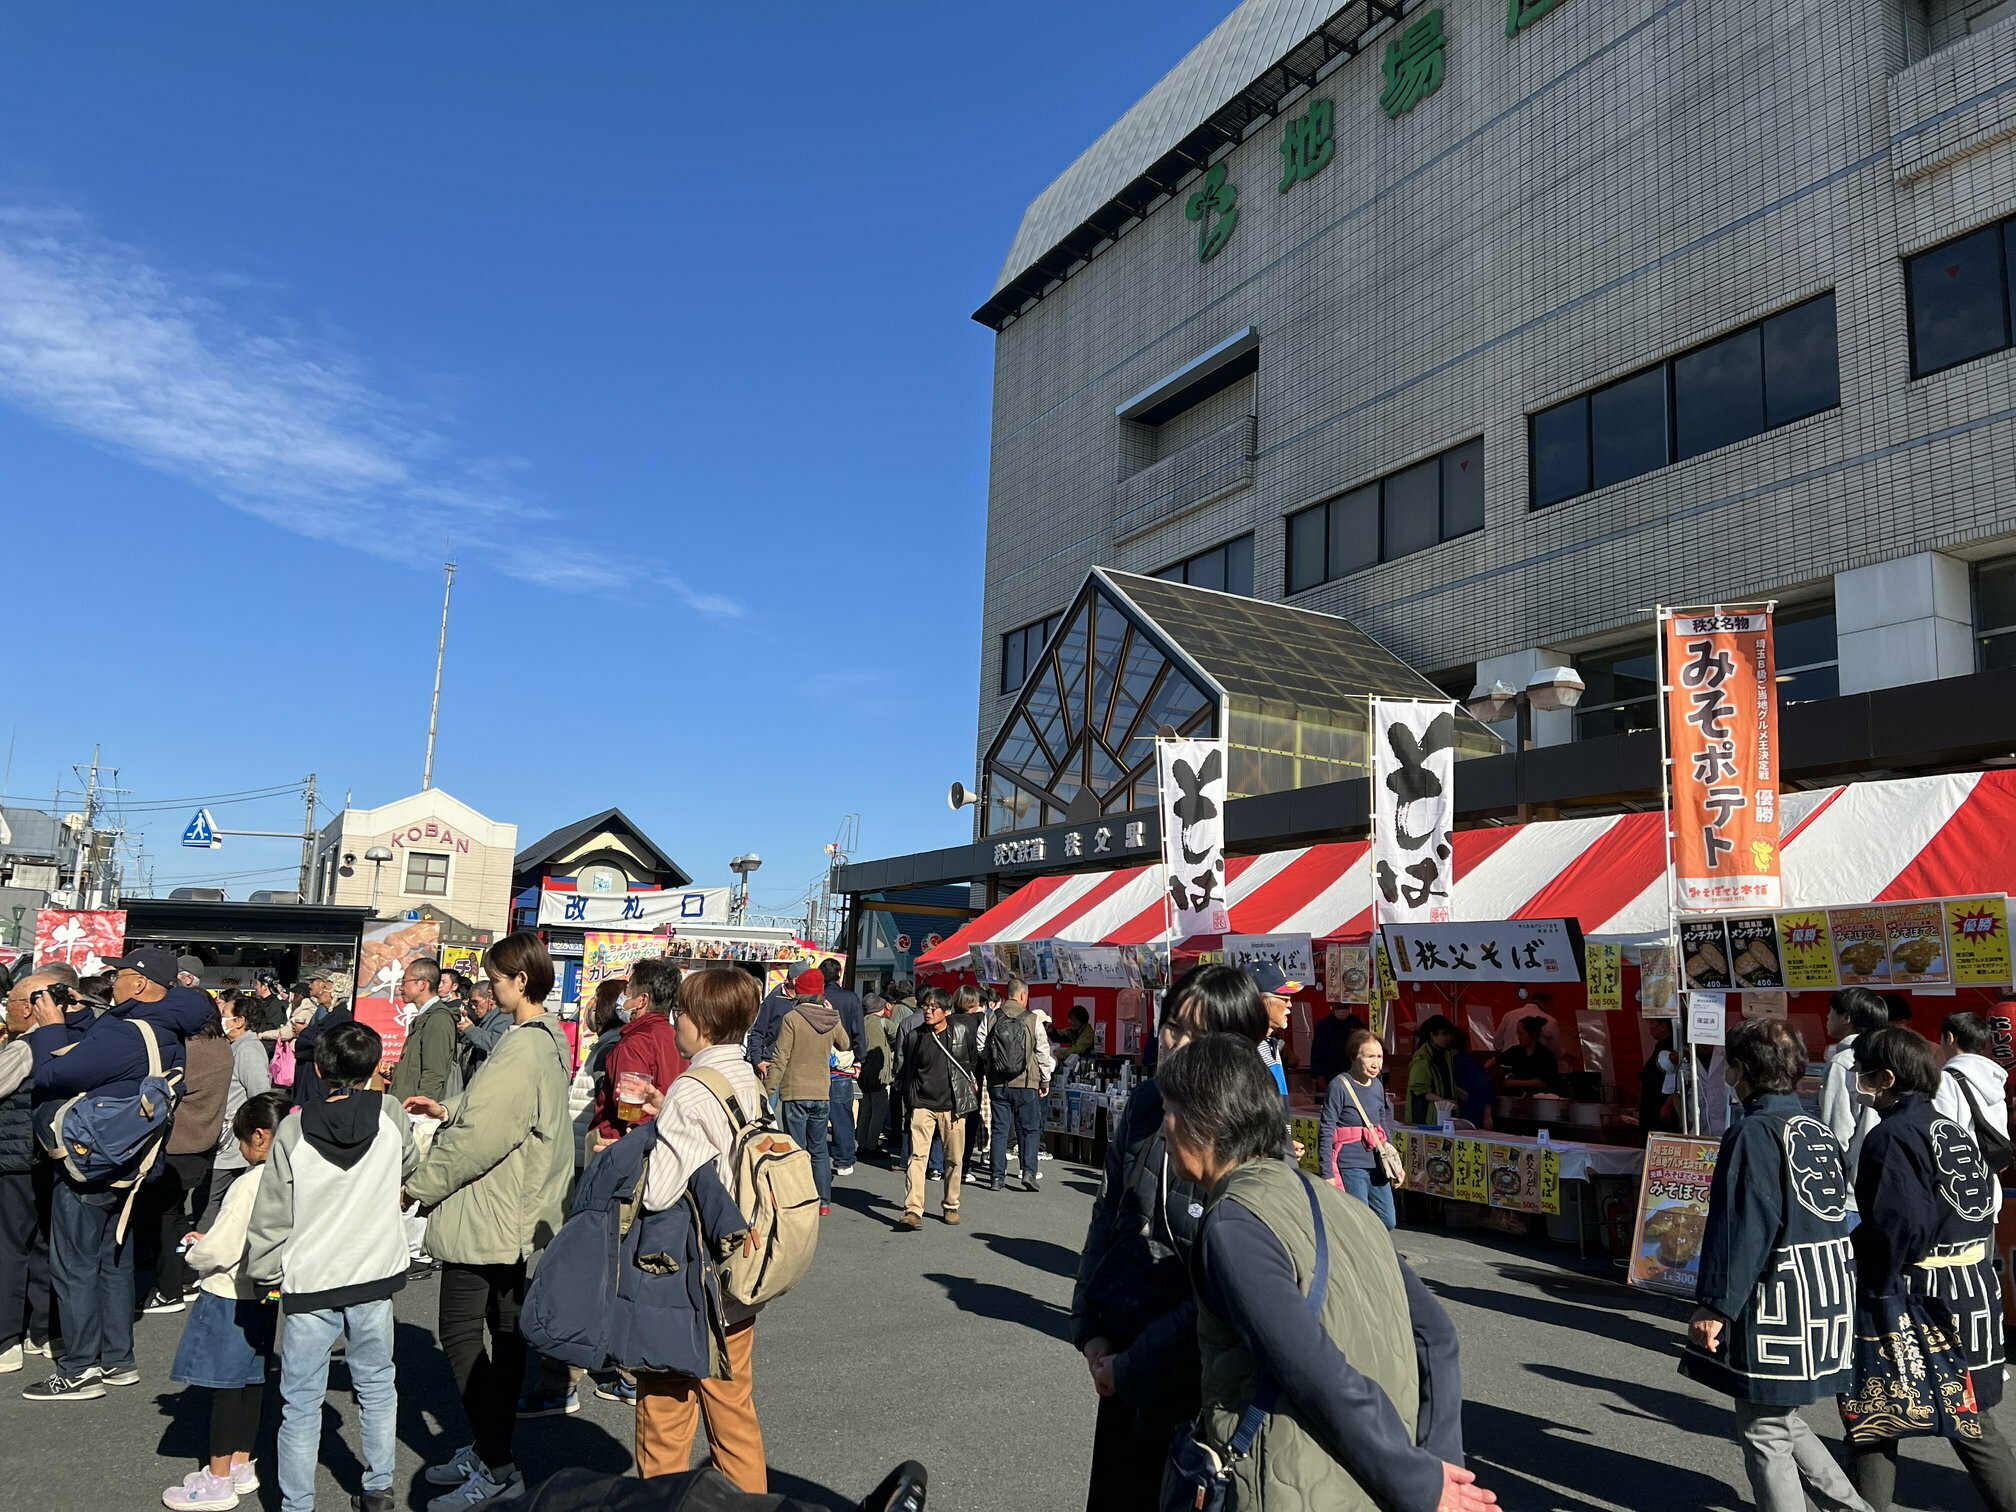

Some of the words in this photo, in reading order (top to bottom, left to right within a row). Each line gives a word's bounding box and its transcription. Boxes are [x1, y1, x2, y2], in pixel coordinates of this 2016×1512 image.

[1692, 616, 1750, 632] 秩父名物
[1755, 639, 1769, 780] 埼玉B級ご当地グルメ王決定戦
[1681, 640, 1747, 867] みそポテト
[1755, 789, 1774, 823] 優勝
[391, 823, 469, 854] KOBAN
[993, 837, 1045, 866] 秩父鉄道
[1064, 821, 1146, 857] 秩父駅
[565, 894, 705, 921] 改札口
[1688, 883, 1768, 898] みそぽてと本舗
[1683, 929, 1722, 941] メンチカツ
[1731, 927, 1772, 938] メンチカツ
[1792, 928, 1817, 942] 優勝
[1963, 917, 1992, 932] 優勝
[1414, 938, 1545, 971] 秩父そば
[1603, 944, 1616, 994] 秩父そば
[1410, 1137, 1419, 1176] 秩父うどん
[1457, 1140, 1468, 1186] 秩父そば
[1472, 1141, 1483, 1188] 秩父そば
[1542, 1149, 1554, 1198] 秩父そば
[1526, 1153, 1535, 1196] 秩父うどん
